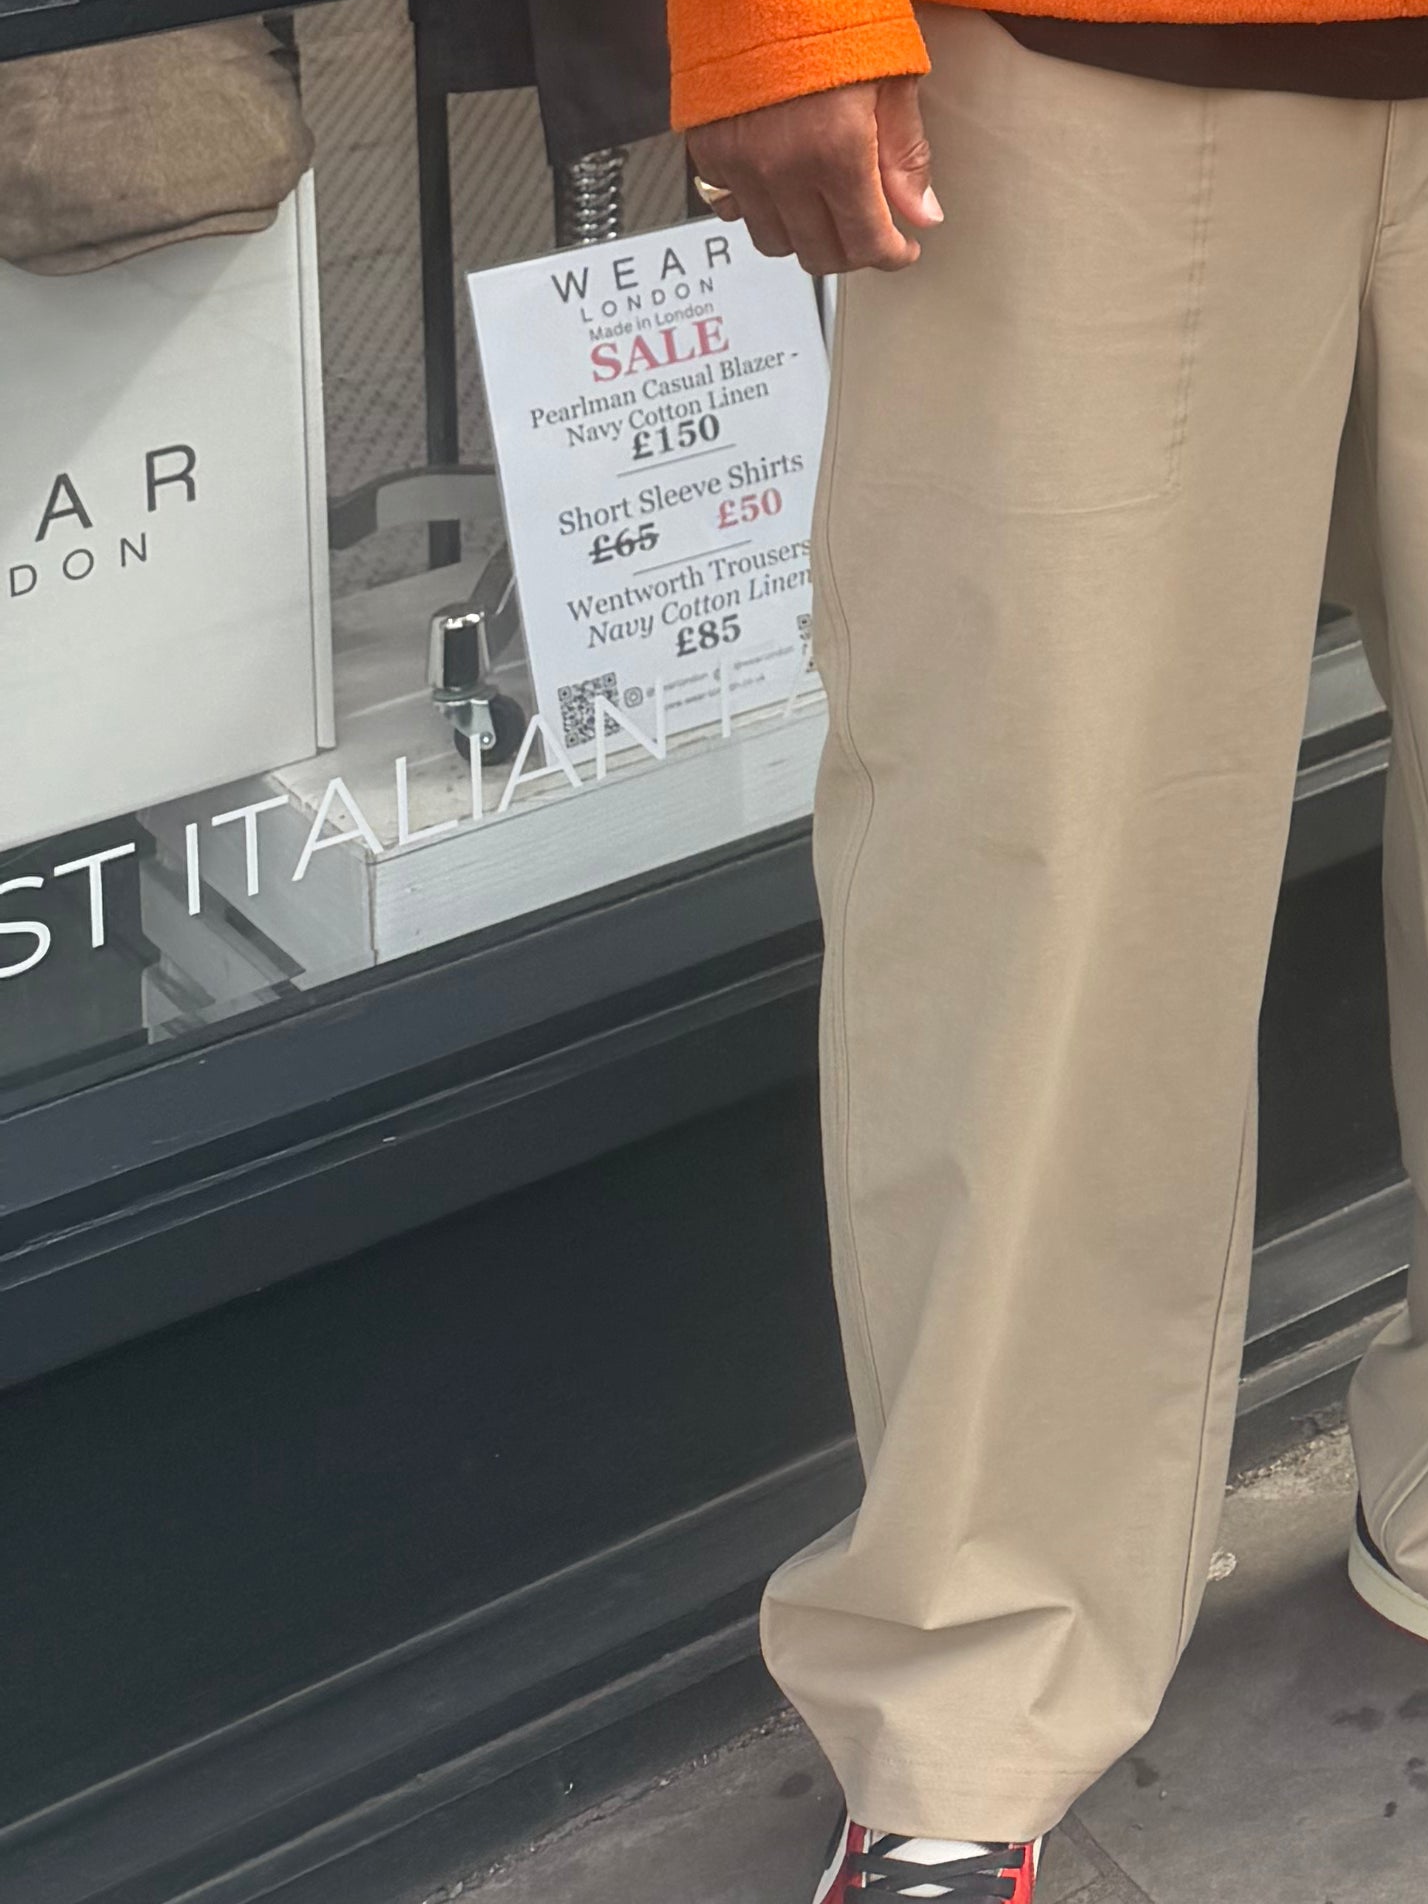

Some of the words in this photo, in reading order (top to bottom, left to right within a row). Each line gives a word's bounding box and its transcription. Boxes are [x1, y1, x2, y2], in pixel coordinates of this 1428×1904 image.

[551, 236, 732, 304] WEAR
[580, 277, 714, 323] LONDON
[589, 321, 632, 342] Made
[637, 315, 651, 331] in
[655, 302, 714, 326] London
[590, 316, 730, 383] SALE
[530, 389, 637, 429] Pearlman
[642, 365, 714, 400] Casual
[721, 349, 785, 381] Blazer
[566, 418, 624, 448] Navy
[628, 399, 702, 429] Cotton
[710, 382, 770, 411] Linen
[632, 414, 721, 461] £150
[558, 497, 632, 536] Short
[638, 476, 722, 515] Sleeve
[728, 453, 804, 490] Shirts
[588, 522, 660, 565] £65
[717, 487, 783, 530] £50
[567, 565, 704, 622] Wentworth
[708, 538, 812, 582] Trousers
[587, 614, 654, 649] Navy
[661, 589, 741, 626] Cotton
[749, 568, 813, 602] Linen
[675, 613, 741, 658] £85
[185, 675, 666, 917] ITALIAN
